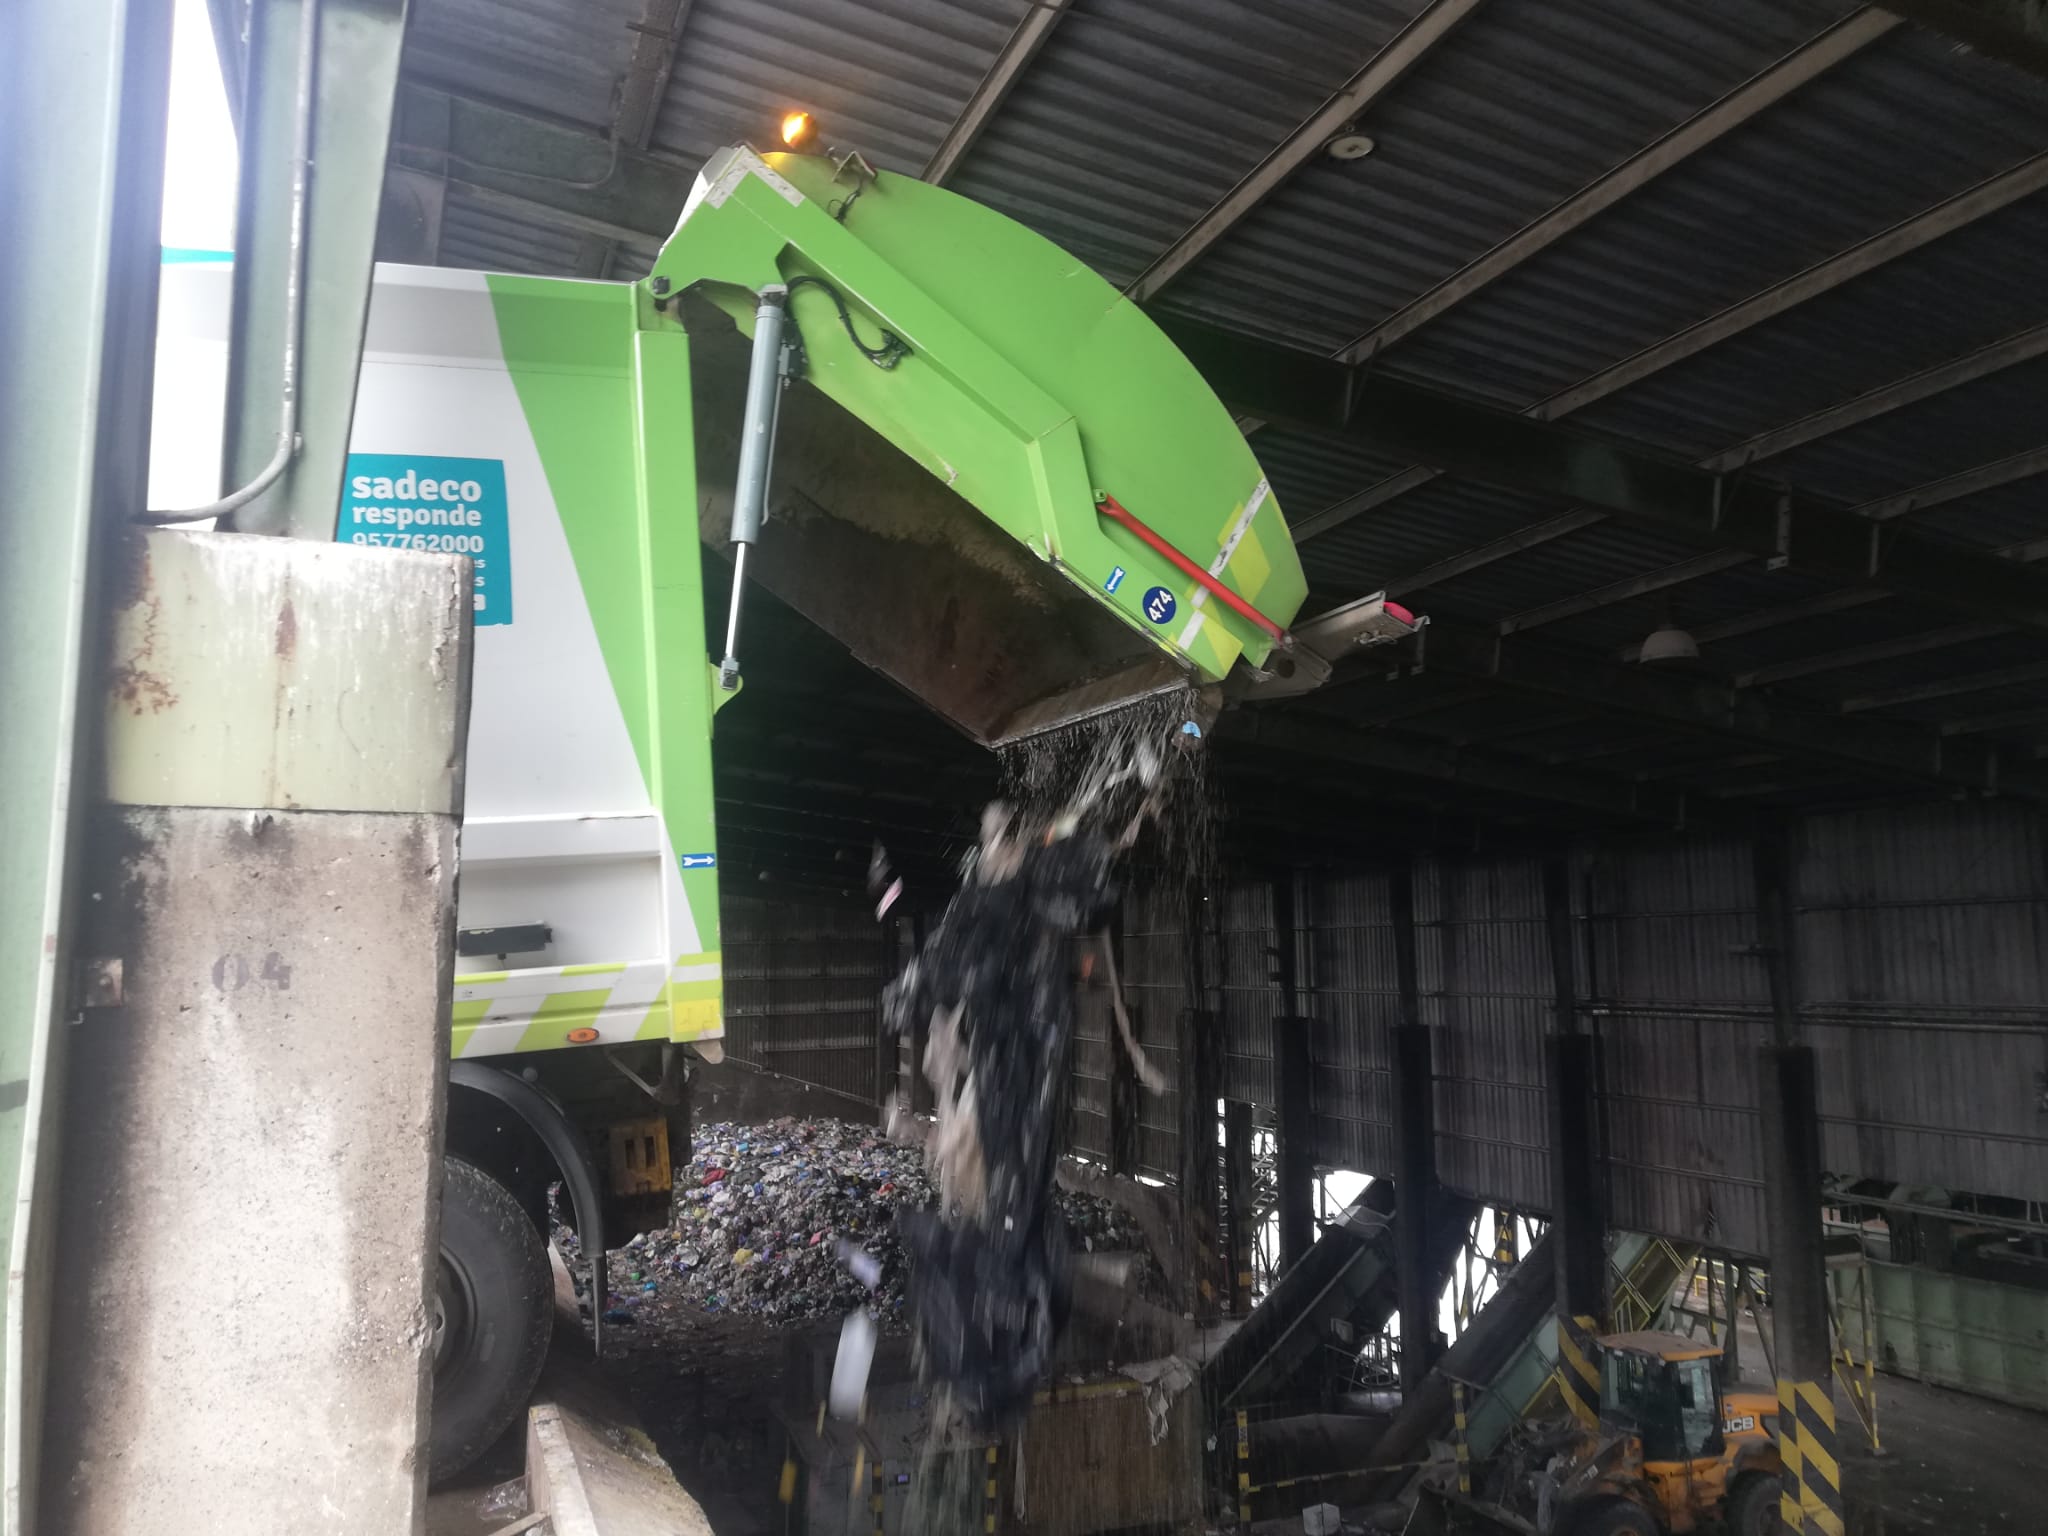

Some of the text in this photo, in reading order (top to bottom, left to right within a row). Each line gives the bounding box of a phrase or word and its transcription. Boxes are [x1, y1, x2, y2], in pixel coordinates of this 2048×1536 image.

[352, 469, 482, 502] sadeco
[352, 503, 482, 530] responde
[352, 532, 484, 553] 957762000
[1148, 590, 1173, 621] 474
[211, 951, 291, 993] 04
[1722, 1416, 1754, 1433] JCB
